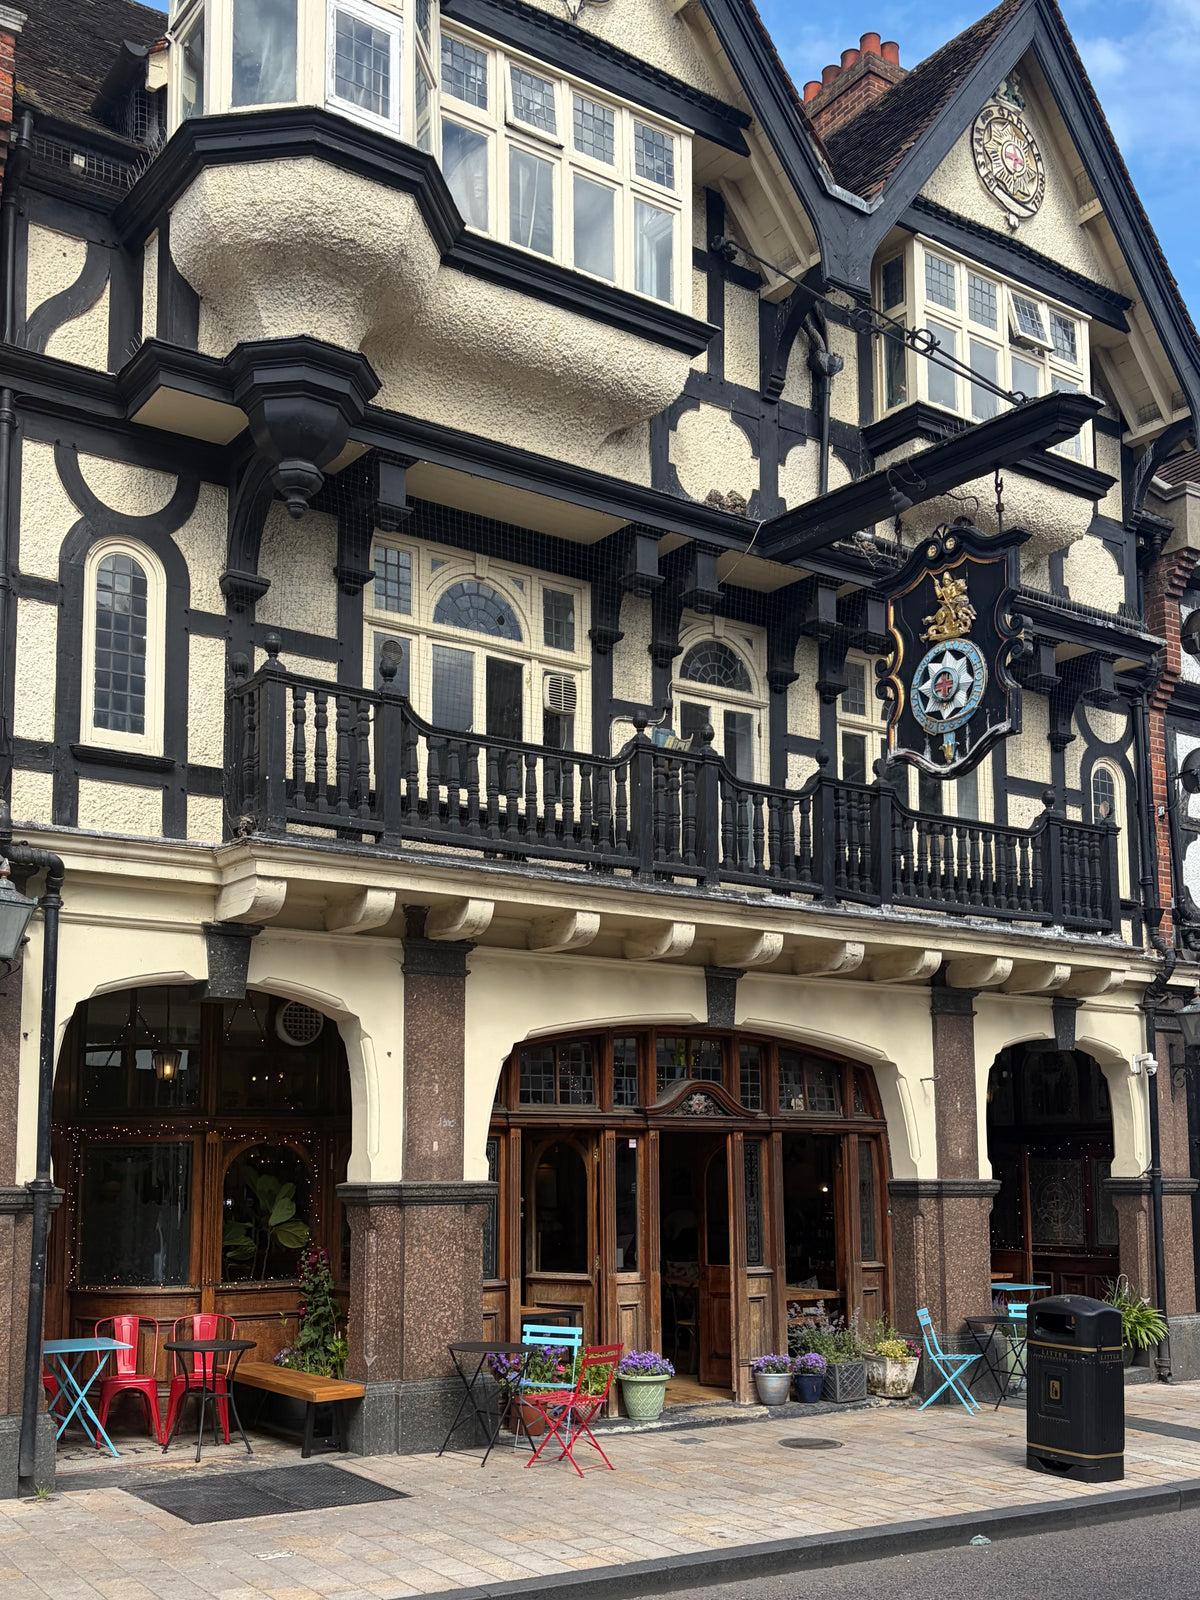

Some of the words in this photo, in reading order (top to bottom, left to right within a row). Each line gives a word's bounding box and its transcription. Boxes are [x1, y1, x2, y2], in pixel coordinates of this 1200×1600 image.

[974, 126, 987, 169] STAR
[998, 106, 1042, 163] GARTER
[1031, 172, 1046, 210] HOTEL
[917, 655, 930, 676] AND
[968, 662, 983, 703] HOTEL
[1041, 1349, 1068, 1359] LITTER
[1100, 1353, 1120, 1361] LITTER
